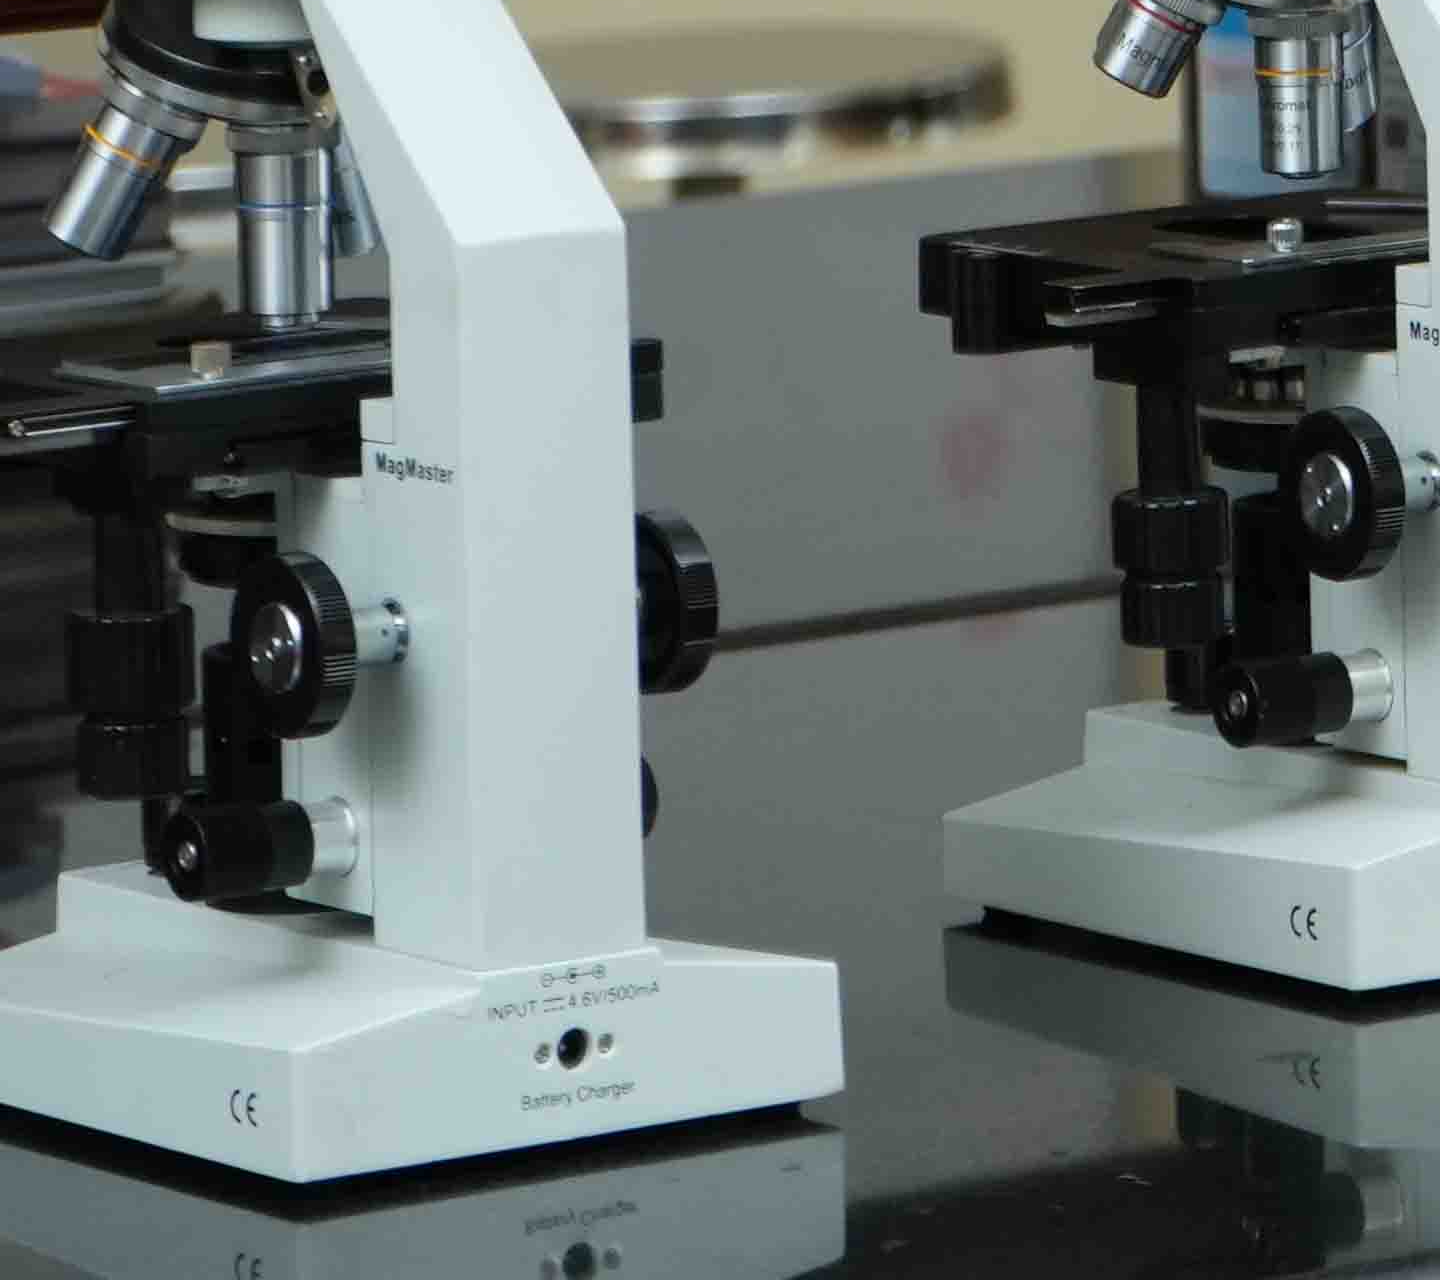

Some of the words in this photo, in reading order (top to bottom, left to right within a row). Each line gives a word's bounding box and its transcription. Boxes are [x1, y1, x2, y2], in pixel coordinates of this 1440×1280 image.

[375, 451, 454, 484] MagMaster
[1290, 905, 1319, 941] CE
[488, 1000, 538, 1021] INPUT
[229, 1088, 258, 1127] CE
[520, 1092, 572, 1112] Battery
[576, 1080, 637, 1102] Charger
